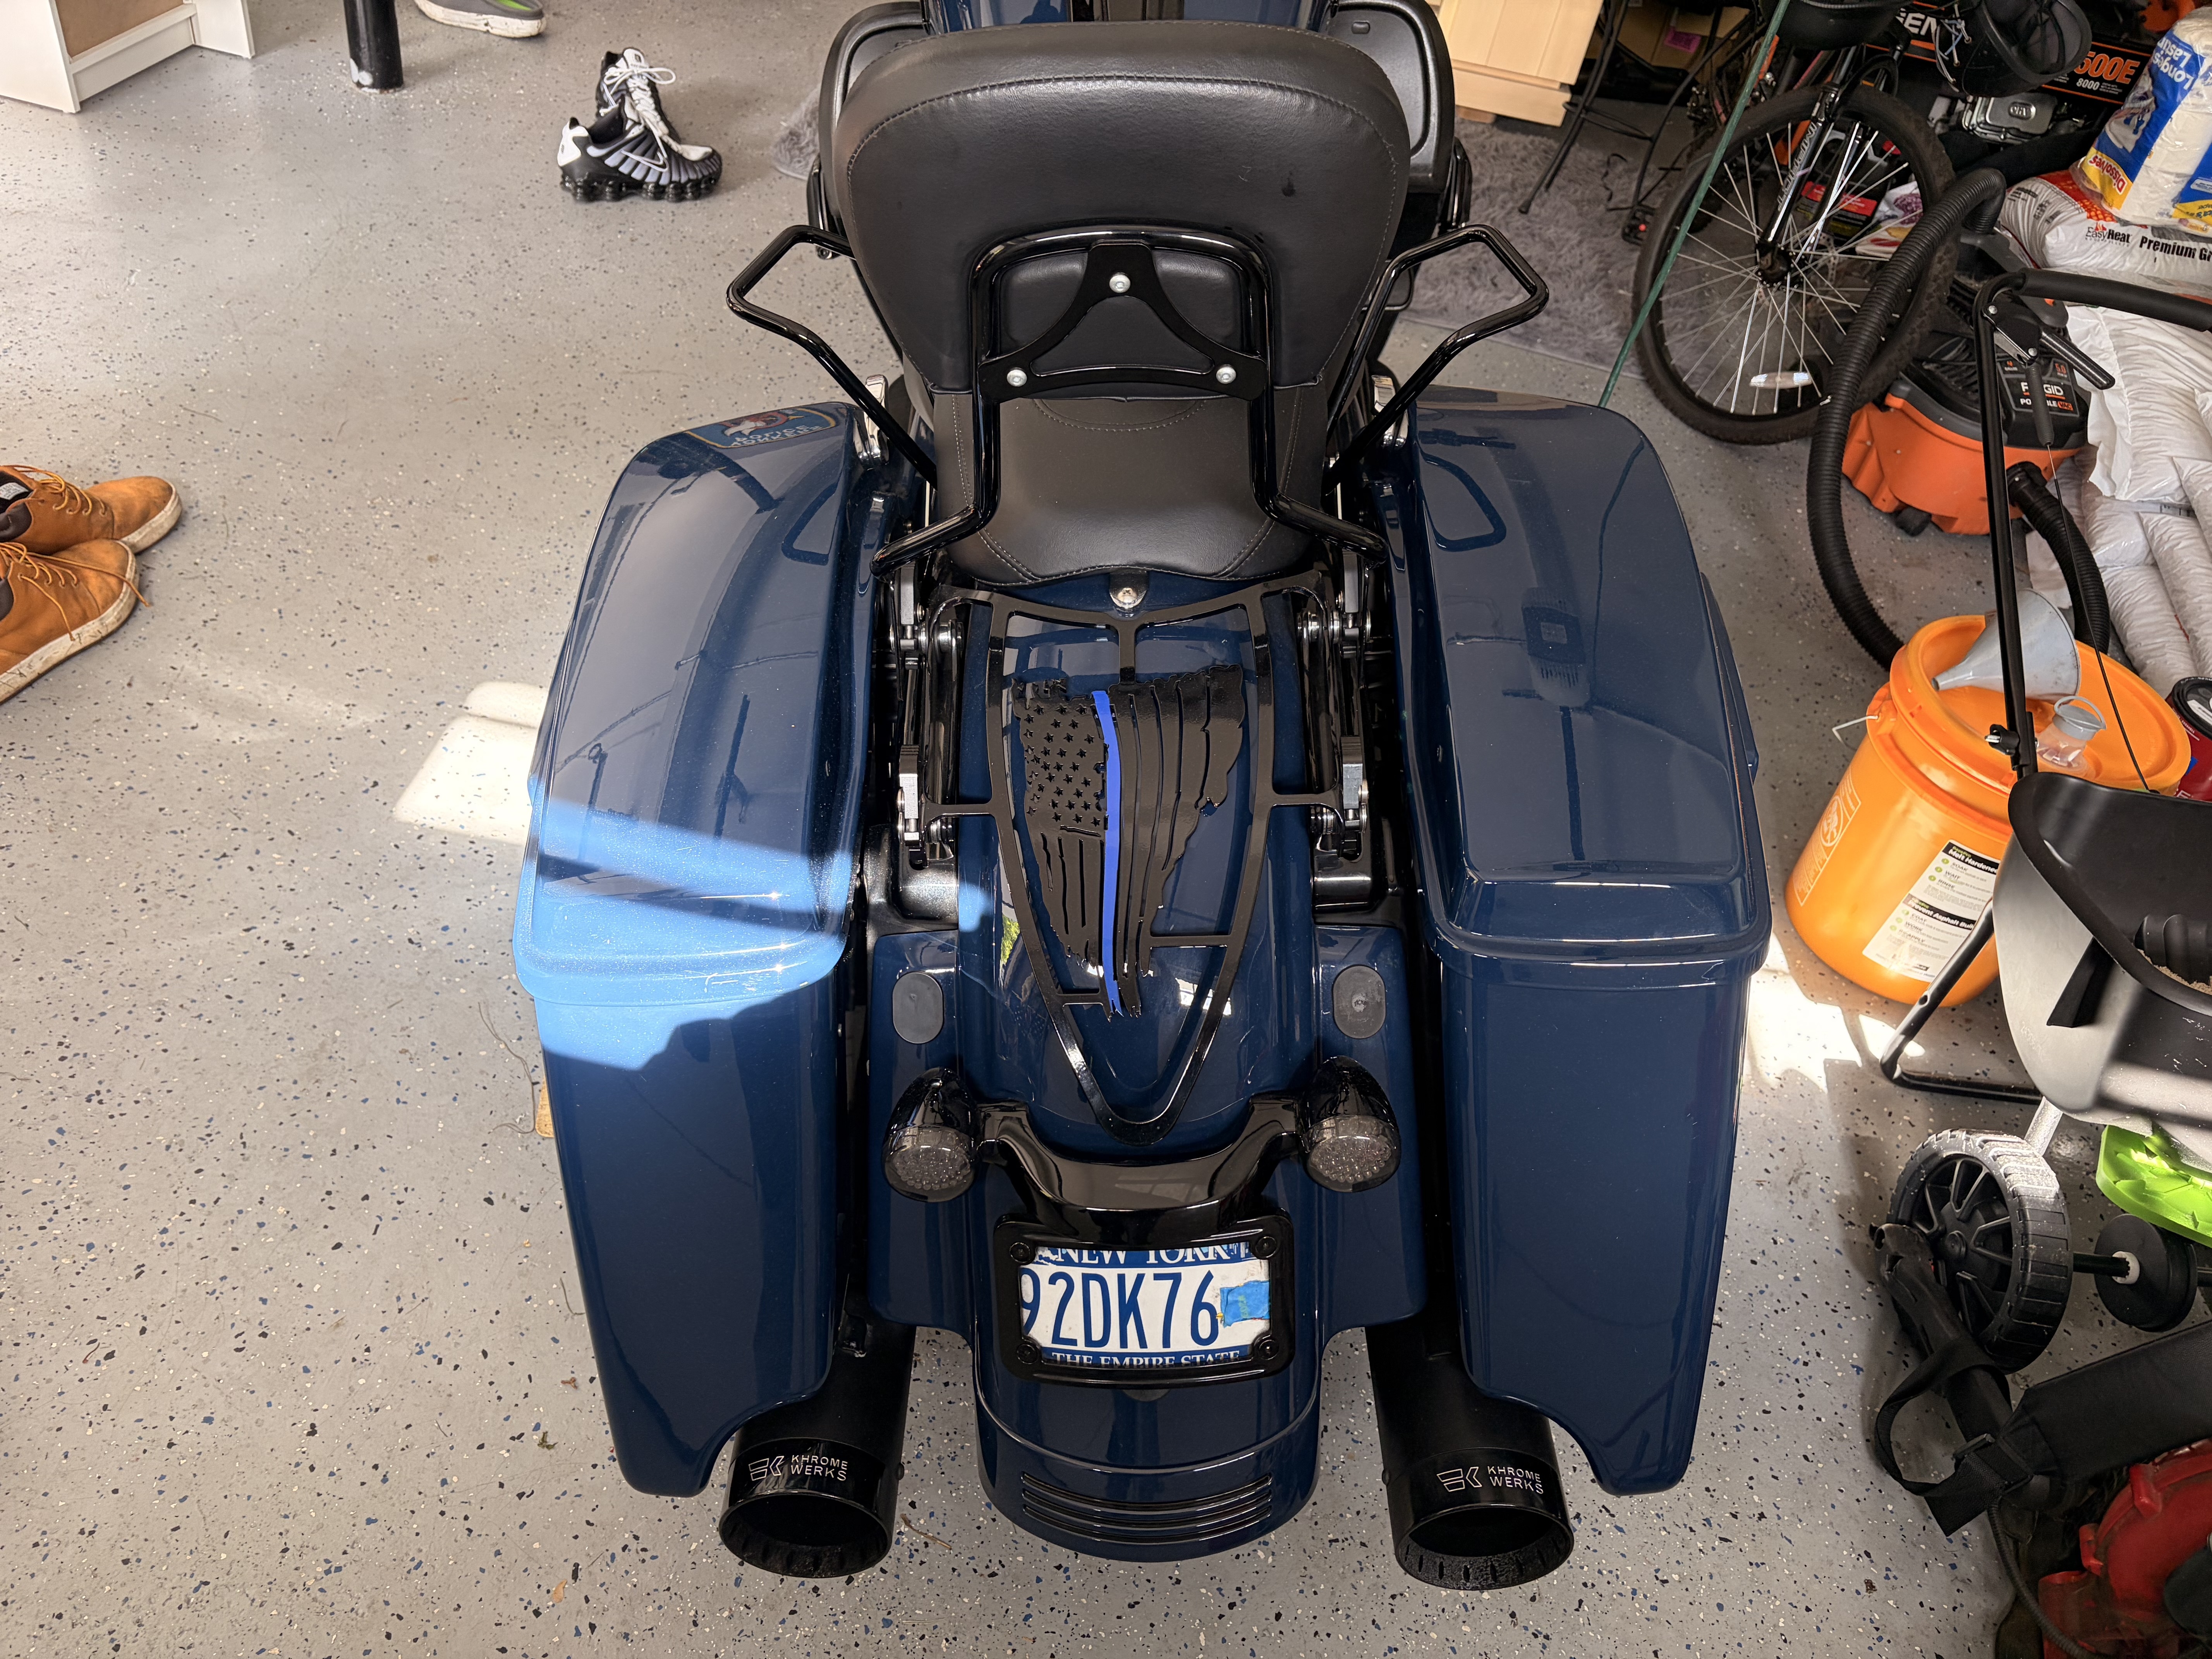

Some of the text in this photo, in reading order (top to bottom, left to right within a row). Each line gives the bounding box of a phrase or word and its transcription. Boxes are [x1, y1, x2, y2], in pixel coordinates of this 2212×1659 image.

[2076, 78, 2100, 91] 8000
[2088, 155, 2126, 194] Dissolves
[2139, 235, 2197, 259] Premium
[1948, 849, 1965, 861] Melt
[1908, 900, 1934, 917] Prevent
[1933, 913, 1960, 927] Asphalt
[1020, 1267, 1219, 1349] 92DK76
[791, 1454, 848, 1471] KHROME
[790, 1464, 847, 1481] WERKS
[1487, 1465, 1542, 1483] KHROME
[1489, 1476, 1544, 1494] WERKS
